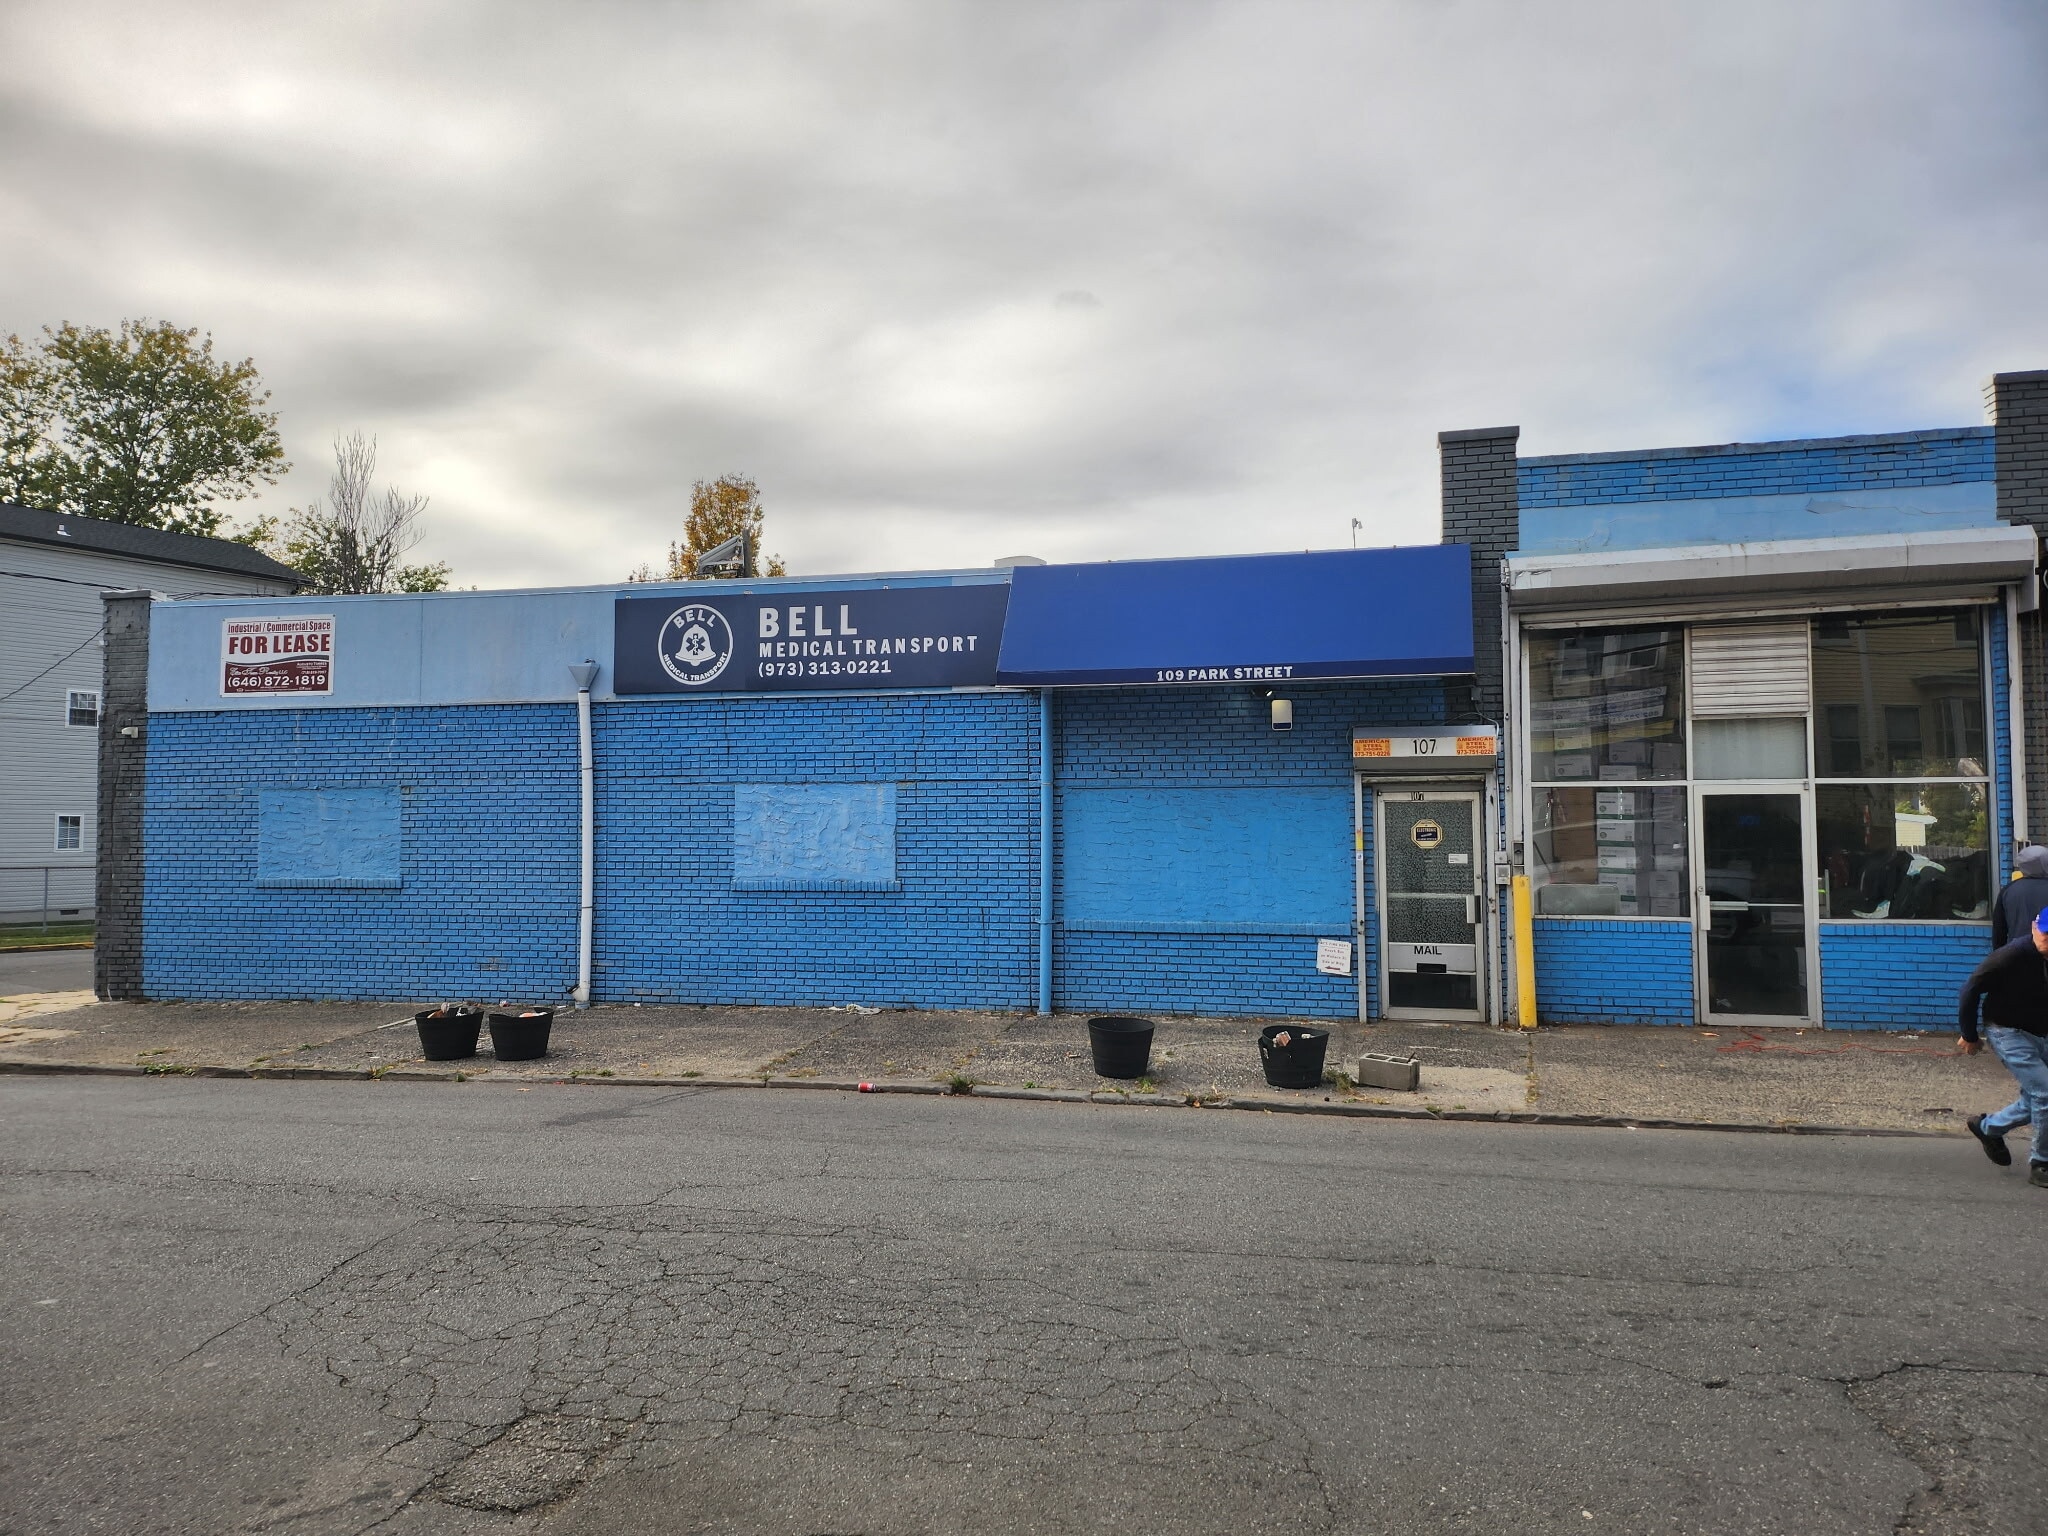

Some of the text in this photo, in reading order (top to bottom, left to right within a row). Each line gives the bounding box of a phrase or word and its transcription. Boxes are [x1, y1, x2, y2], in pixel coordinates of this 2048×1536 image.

[228, 623, 262, 633] Industrial
[266, 621, 308, 632] Commercial
[309, 621, 331, 632] Space
[673, 609, 716, 629] BELL
[759, 604, 858, 638] BELL
[228, 634, 330, 654] FOR LEASE
[759, 635, 978, 658] MEDICAL TRANSPORT
[663, 652, 729, 681] MEDICAL TRANSPORT
[758, 659, 891, 677] (973) 313-0221
[1157, 666, 1293, 681] 109 PARK STREET
[228, 675, 326, 687] (646) 872-1819
[1412, 739, 1436, 755] 107
[1414, 945, 1442, 955] MAIL
